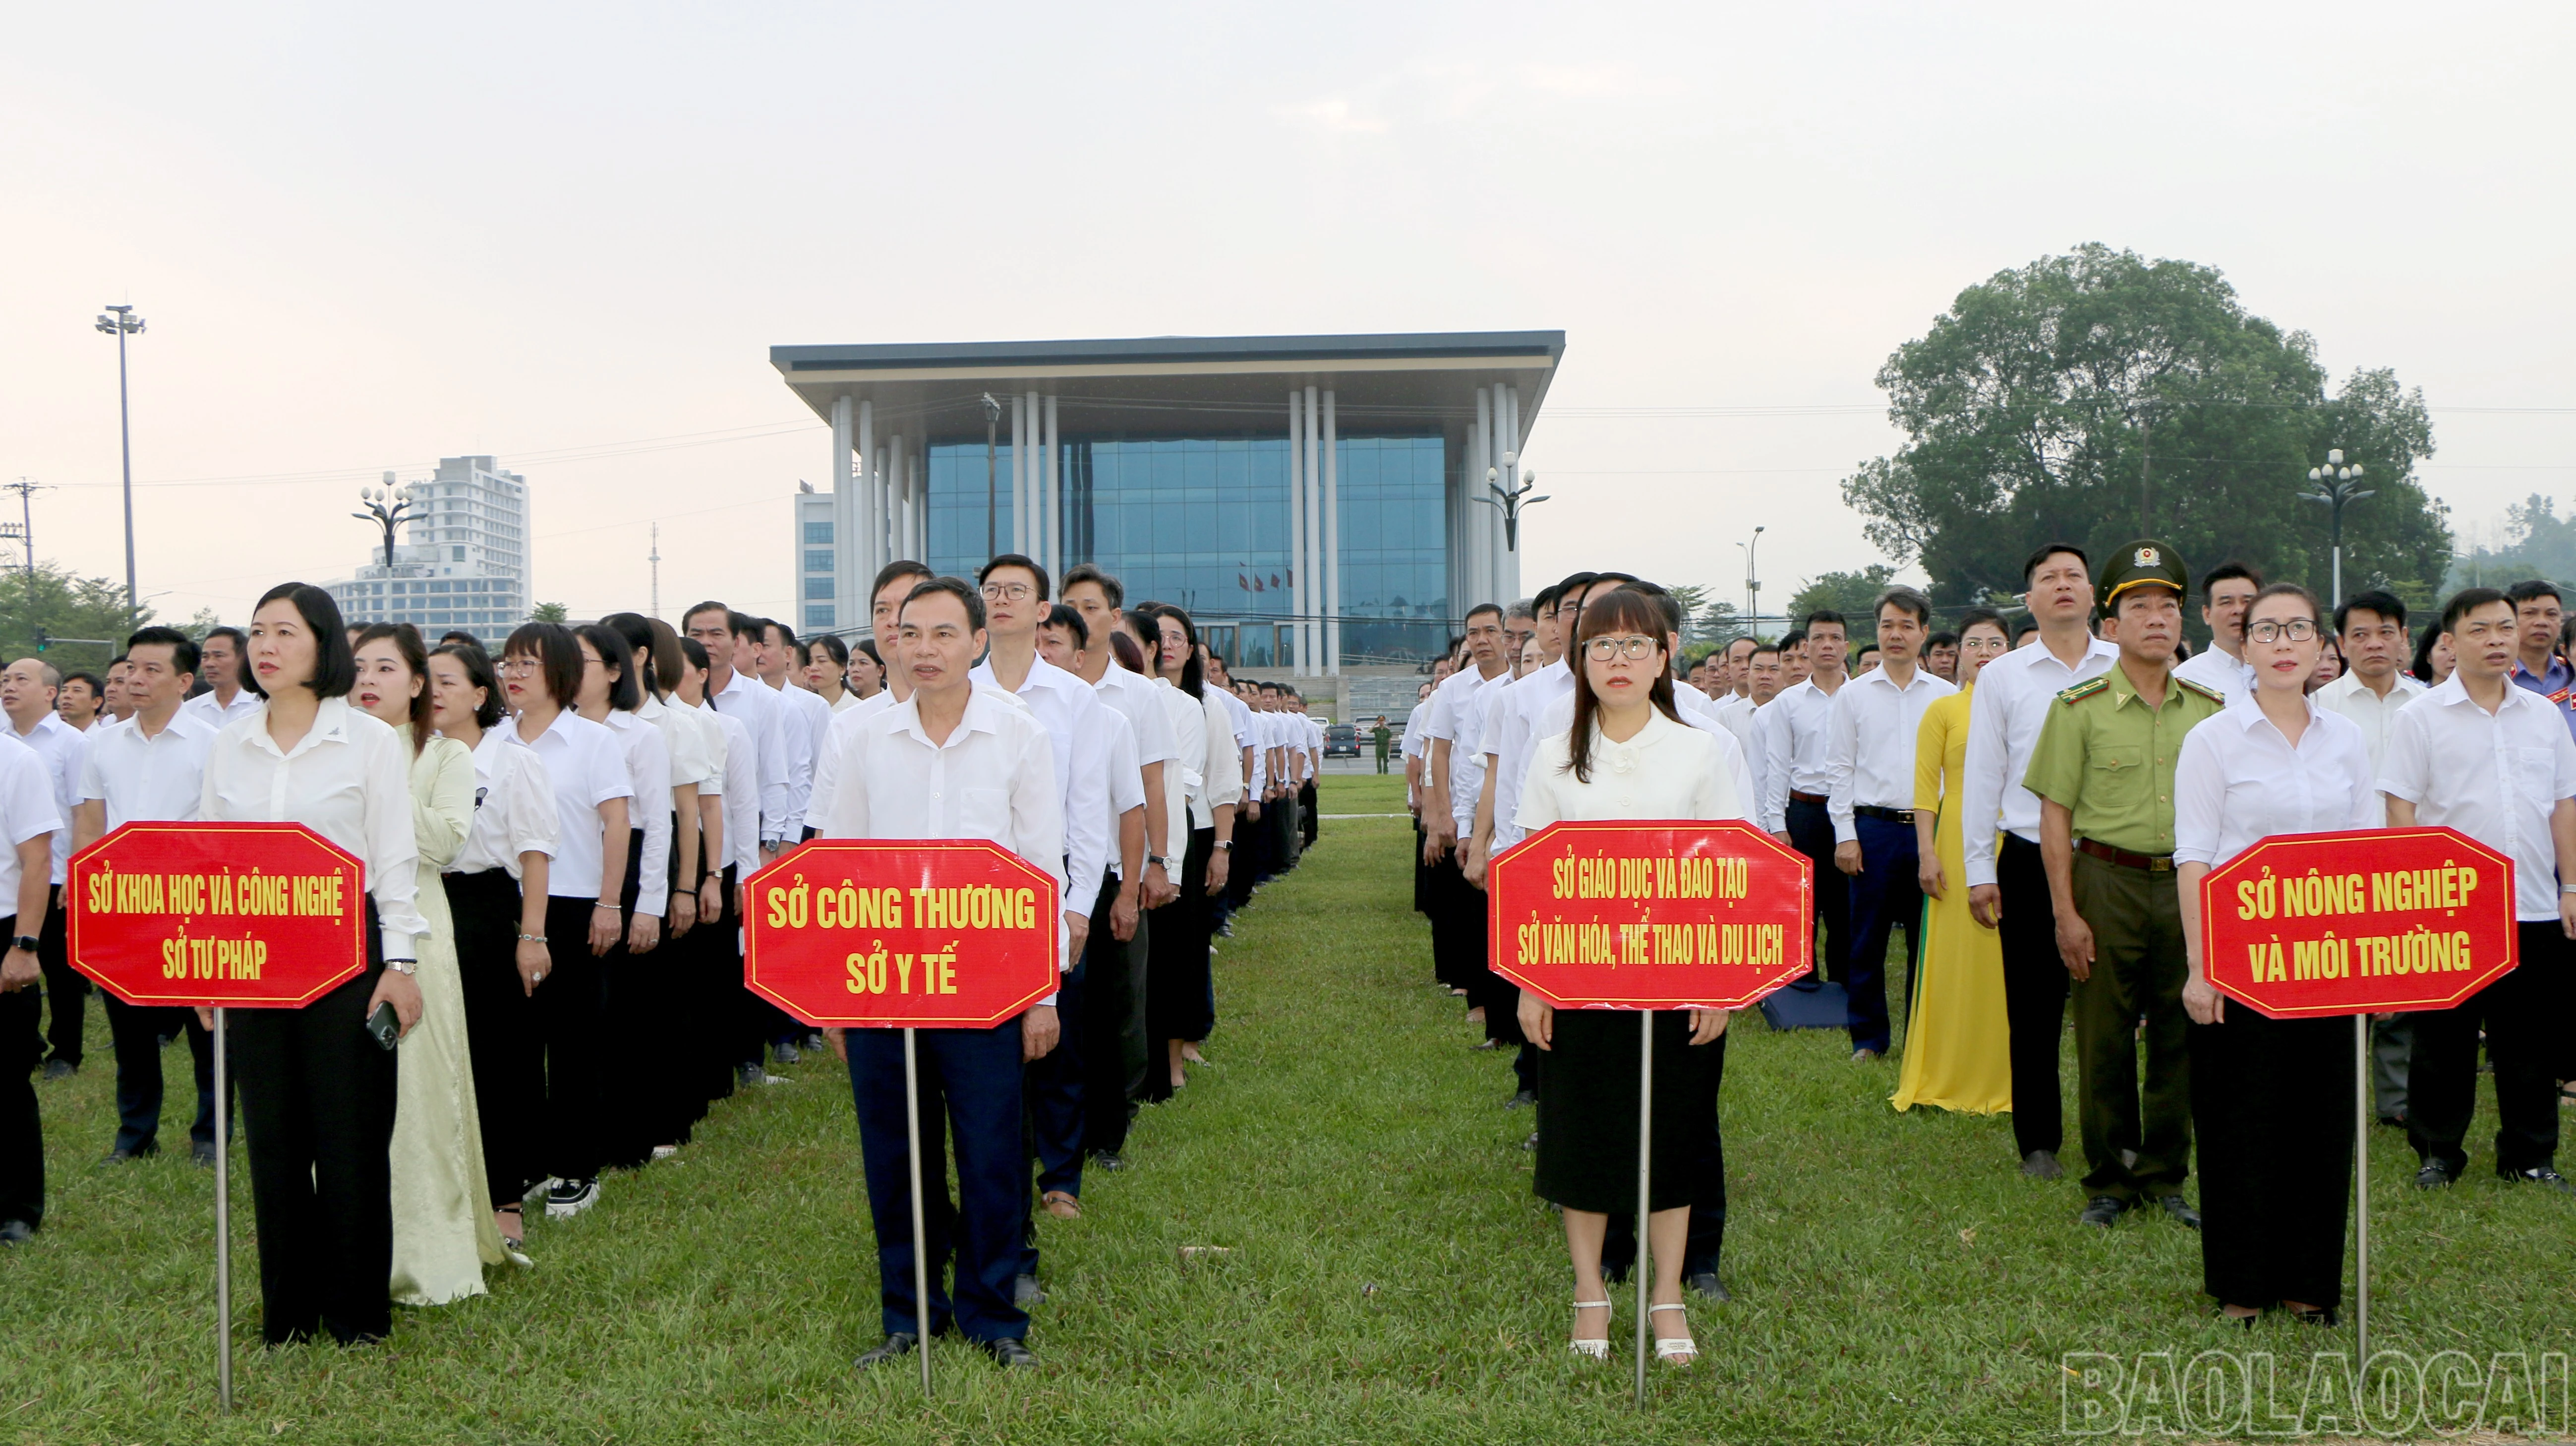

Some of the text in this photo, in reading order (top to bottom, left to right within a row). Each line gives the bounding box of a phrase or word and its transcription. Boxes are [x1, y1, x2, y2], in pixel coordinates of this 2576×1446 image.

[89, 860, 343, 926] SỞ KHOA HỌC VÀ CÔNG NGHỆ
[767, 873, 1035, 929] SỞ CÔNG THƯƠNG
[1553, 844, 1751, 908] SỞ GIÁO DỤC VÀ ĐÀO TẠO
[2237, 859, 2477, 920] SỞ NÔNG NGHIỆP
[163, 925, 267, 980] SỞ TƯ PHÁP
[846, 939, 959, 995] SỞ Y TẾ
[1518, 906, 1783, 974] SỞ VĂN HÓA, THỂ THAO VÀ DU LỊCH
[2248, 924, 2471, 983] VÀ MÔI TRƯỜNG
